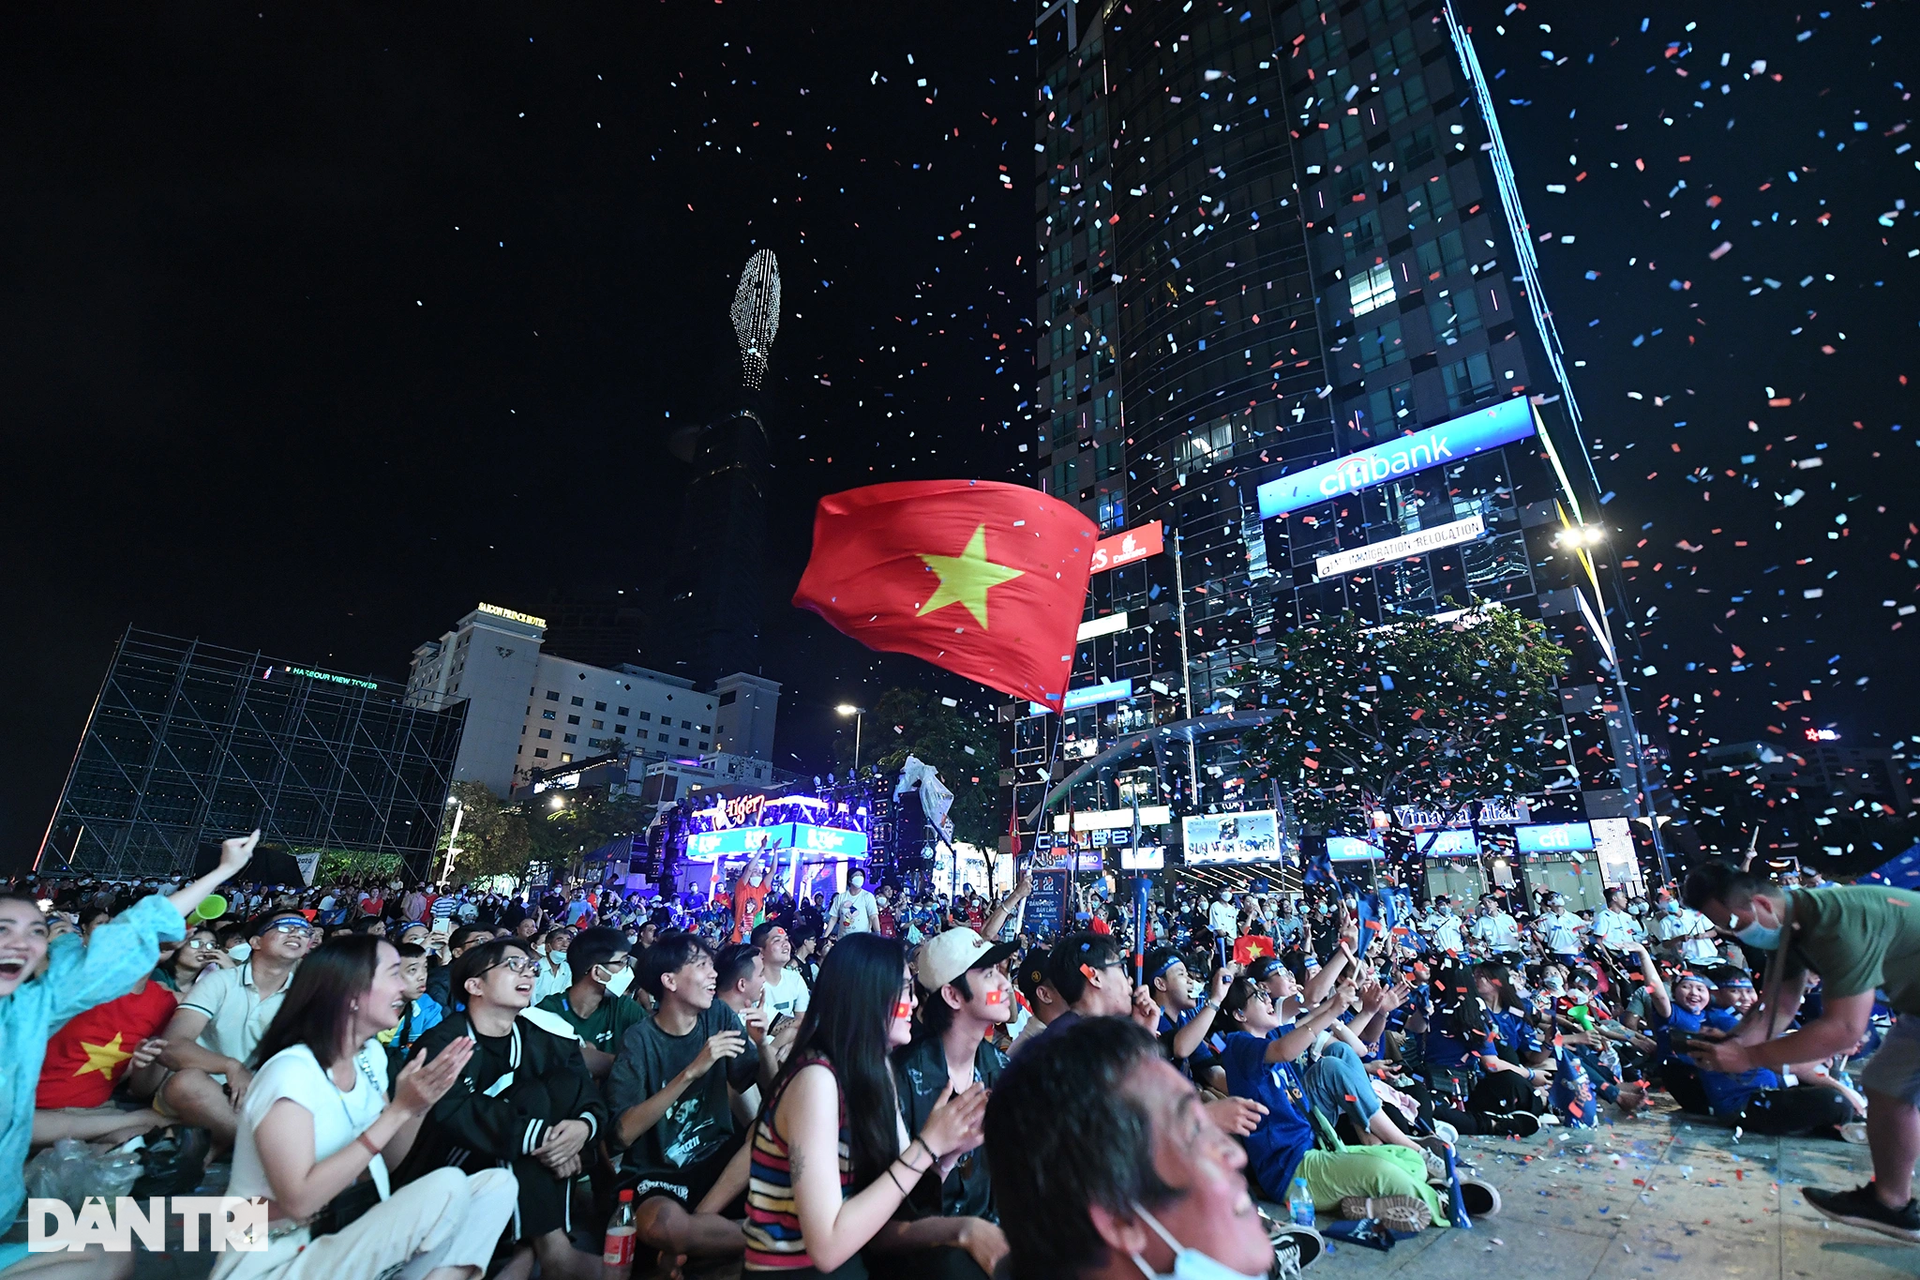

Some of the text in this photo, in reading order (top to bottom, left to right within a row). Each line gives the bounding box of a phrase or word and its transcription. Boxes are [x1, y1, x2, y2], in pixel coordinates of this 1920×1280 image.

[1319, 434, 1453, 496] citibank
[1349, 522, 1479, 565] IMMIGRATION RELOCATION
[478, 601, 504, 616] SAIGON
[526, 614, 547, 628] HOTEL
[292, 667, 378, 690] HARBOUR VIEW TOWER
[726, 795, 759, 825] Tiger
[1343, 840, 1367, 856] citi
[1434, 834, 1462, 852] citi
[1539, 828, 1570, 848] citi
